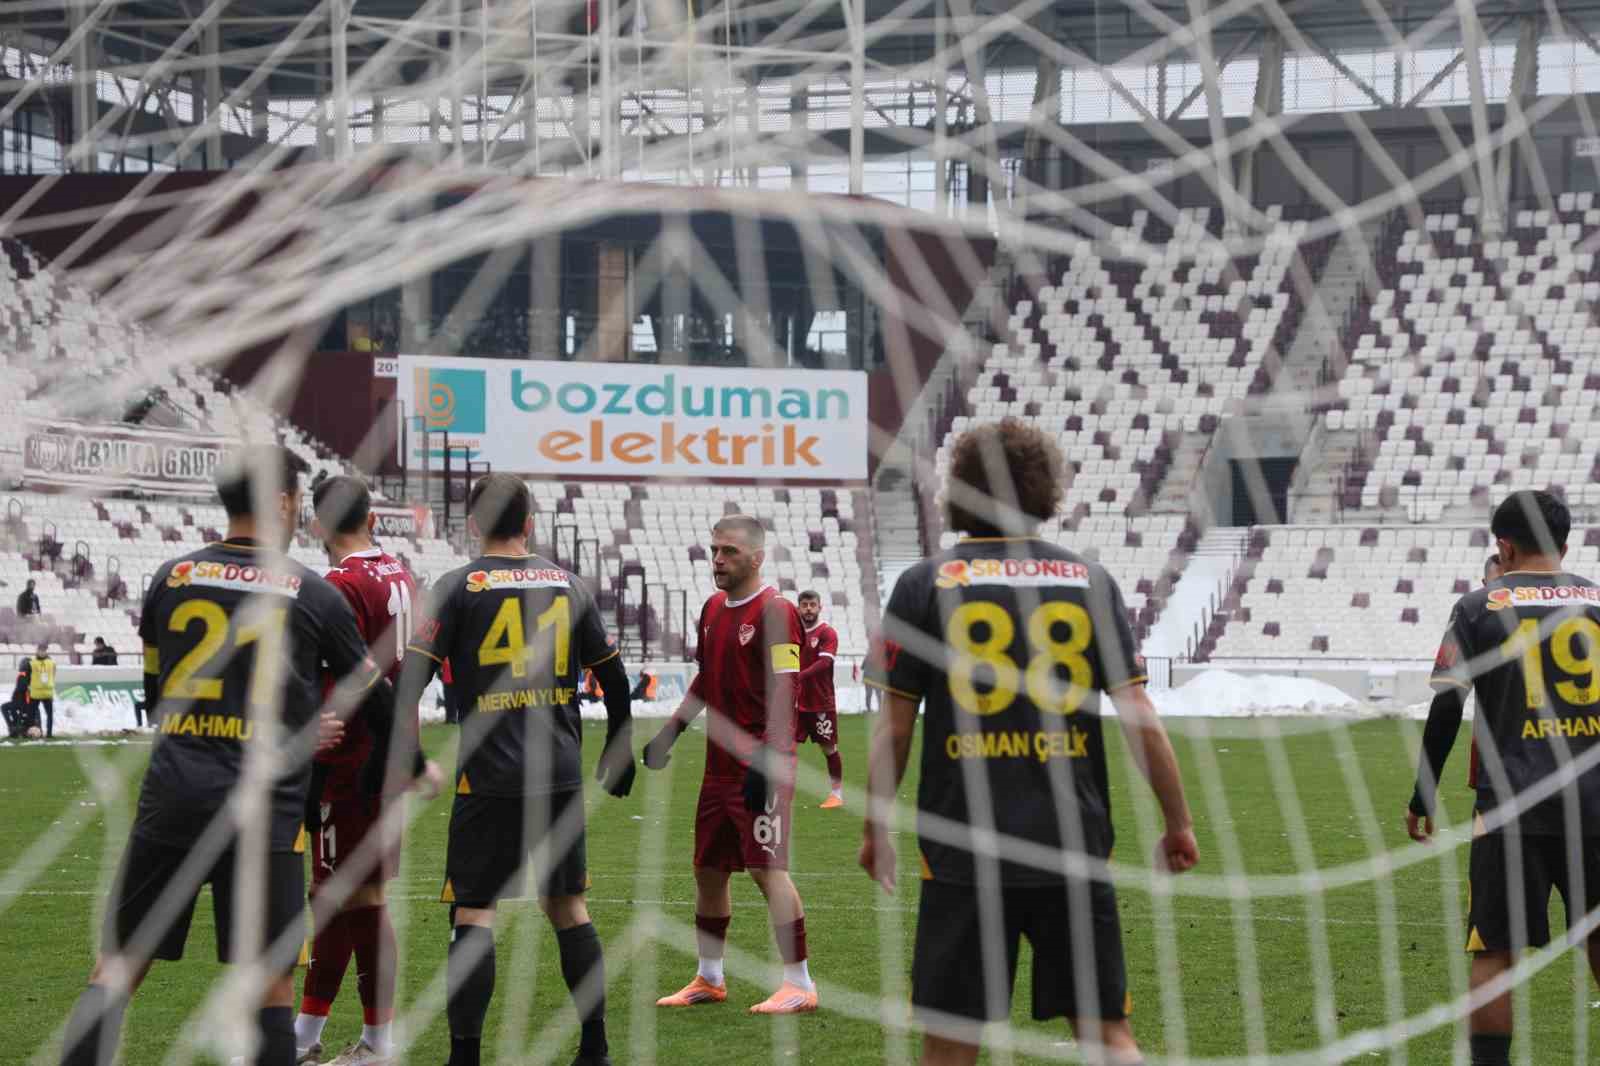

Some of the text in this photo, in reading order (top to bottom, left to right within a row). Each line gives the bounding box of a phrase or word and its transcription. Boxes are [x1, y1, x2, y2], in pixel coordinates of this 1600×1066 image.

[510, 369, 850, 419] bozduman
[538, 420, 821, 467] elektrik
[387, 580, 413, 662] 11
[478, 595, 571, 679] 41
[161, 599, 287, 705] 21
[947, 601, 1093, 716] 88
[1503, 616, 1600, 709] 19
[478, 688, 537, 712] MERVAN
[160, 712, 262, 742] MAHMU
[816, 719, 833, 735] 32
[946, 731, 1029, 759] OSMAN
[754, 815, 782, 845] 61
